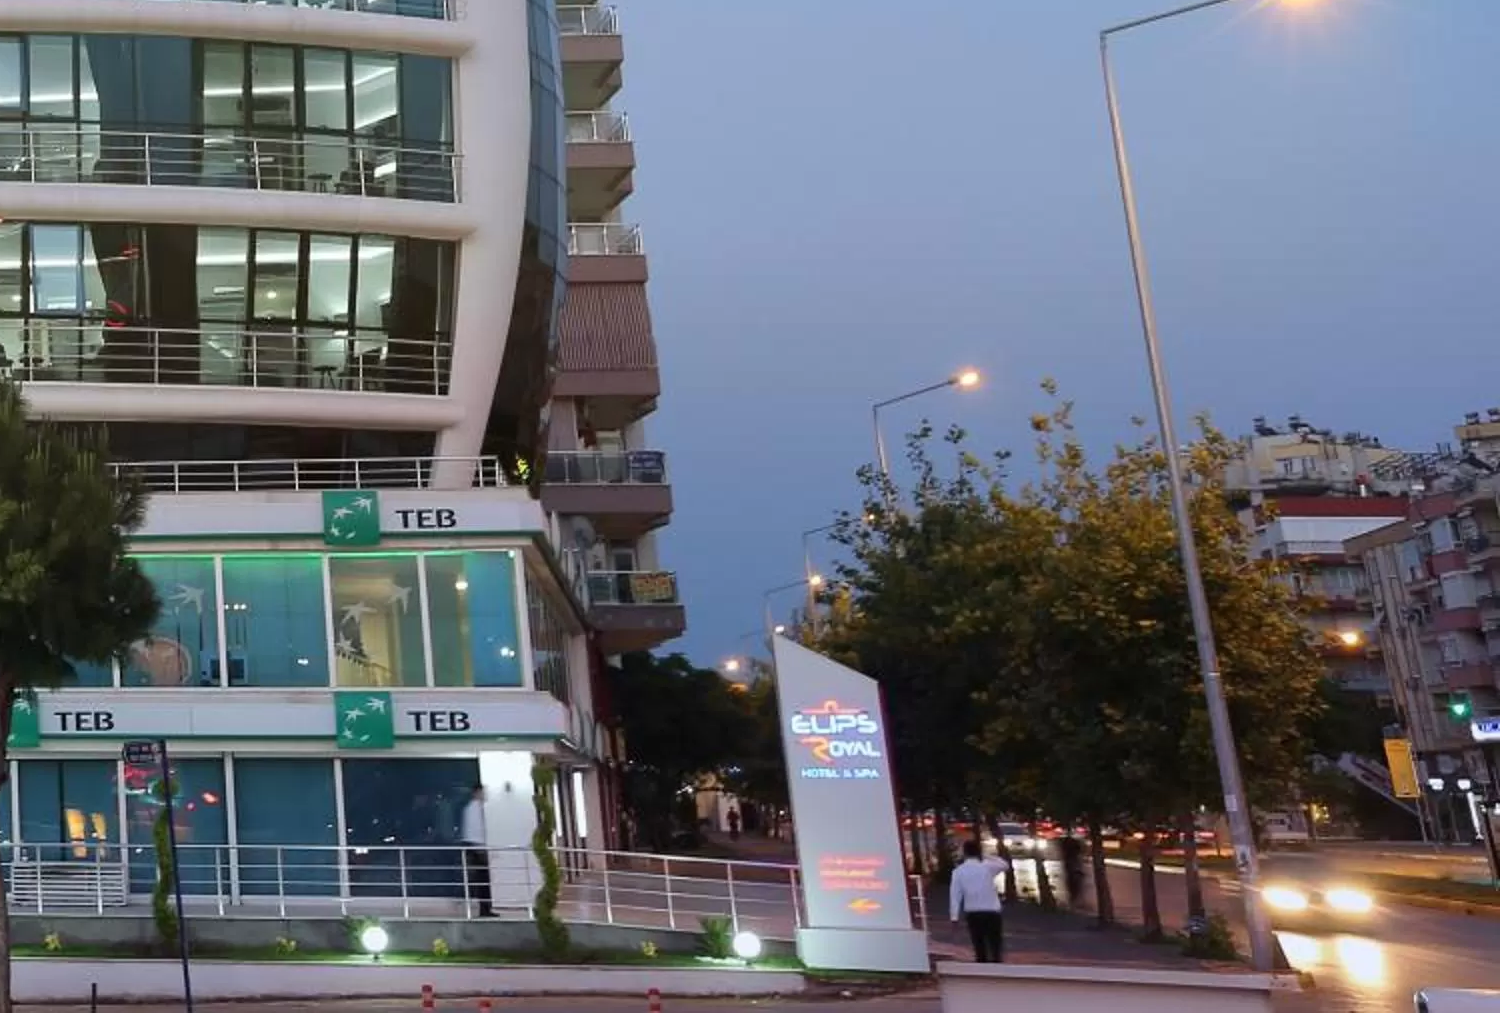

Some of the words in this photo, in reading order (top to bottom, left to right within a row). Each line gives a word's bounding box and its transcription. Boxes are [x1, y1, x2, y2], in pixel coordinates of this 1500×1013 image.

[395, 509, 456, 529] TEB
[54, 711, 115, 731] TEB
[407, 711, 471, 731] TEB
[791, 715, 878, 734] ELIPS
[798, 737, 881, 764] ROYAL
[801, 768, 840, 778] HOTEL
[854, 768, 879, 778] SPA
